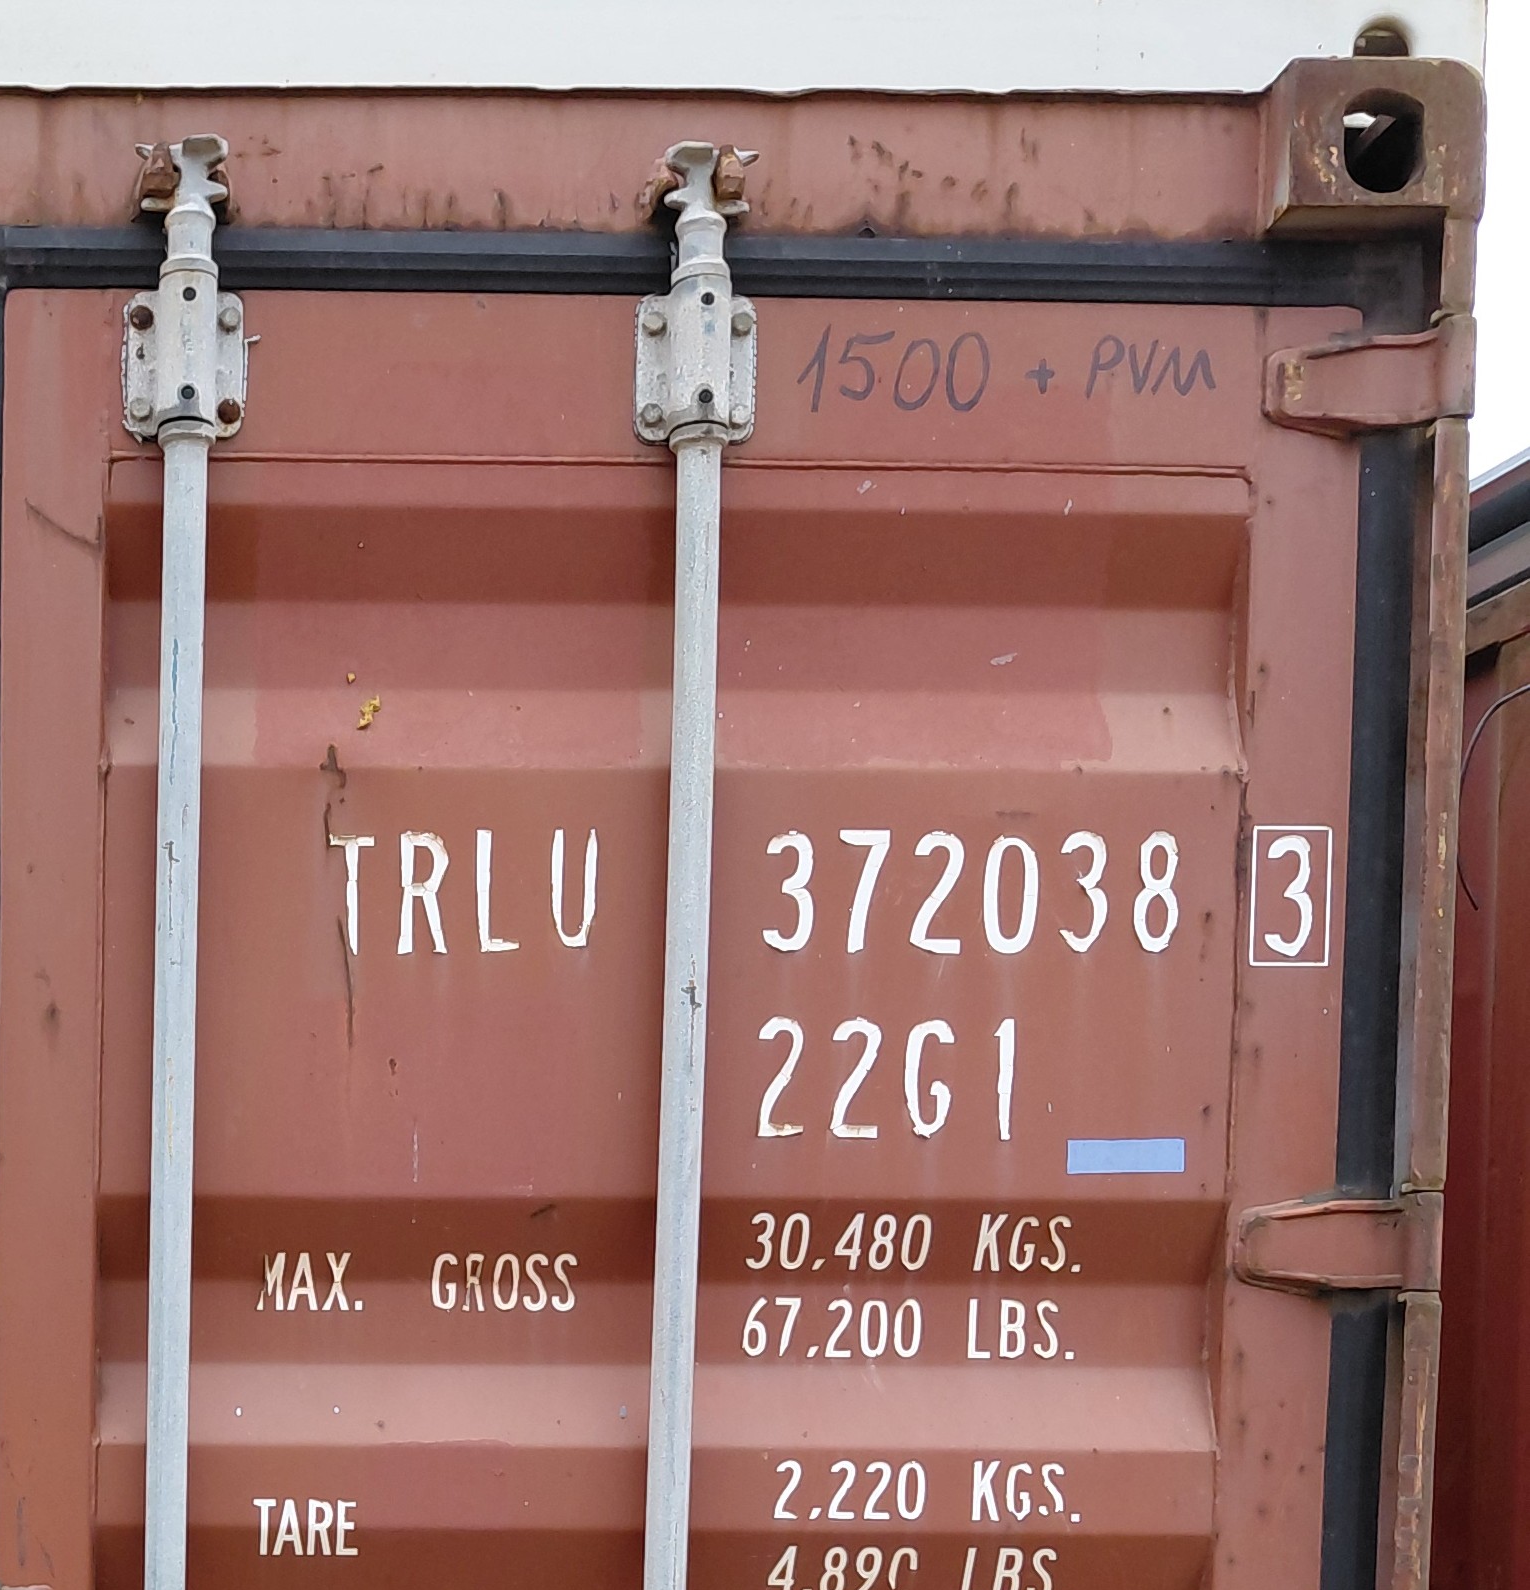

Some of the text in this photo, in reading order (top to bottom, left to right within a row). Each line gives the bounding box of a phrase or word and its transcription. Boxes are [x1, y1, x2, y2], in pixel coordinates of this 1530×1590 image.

[796, 323, 991, 413] 1500
[1085, 334, 1217, 399] PVM
[328, 828, 1314, 958] TRLU 372038 3
[756, 1015, 1016, 1142] 22G1
[971, 1212, 1082, 1274] KGS.
[256, 1252, 579, 1312] MAX. GROSS
[965, 1298, 1076, 1360] LBS.
[971, 1459, 1082, 1523] KGS.
[252, 1498, 359, 1557] TARE
